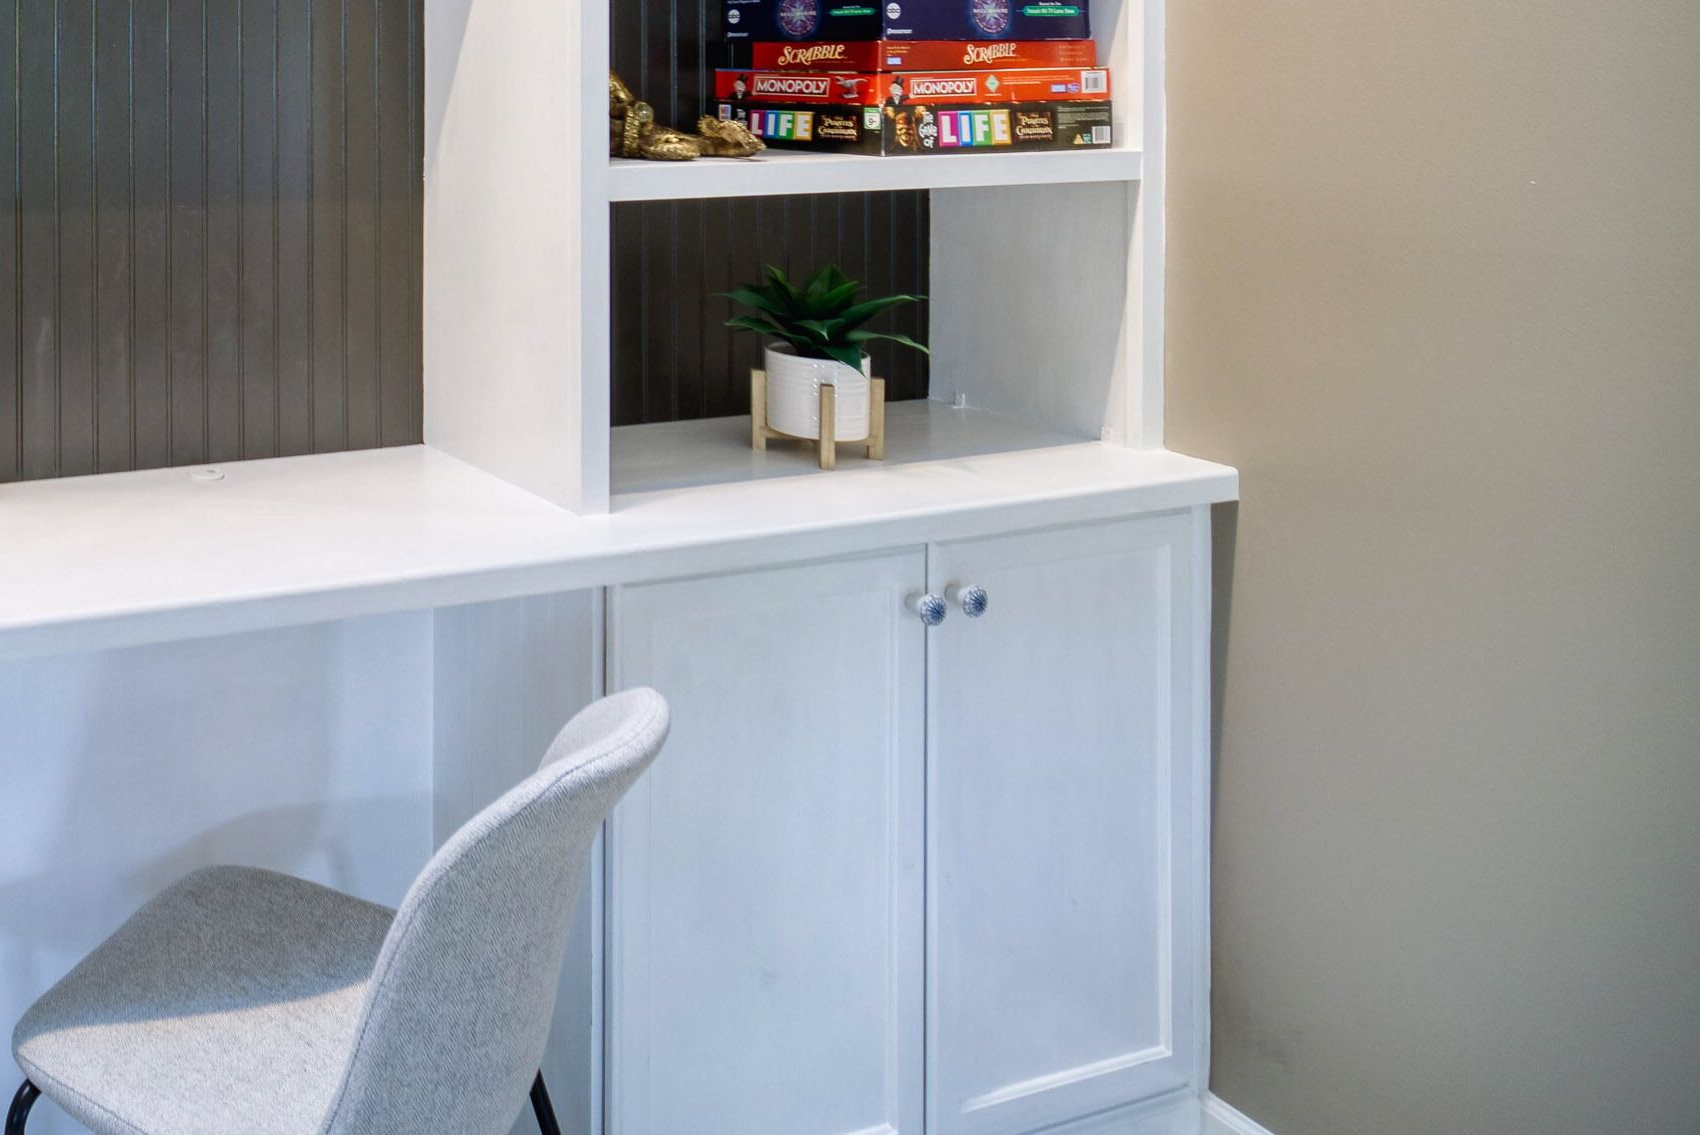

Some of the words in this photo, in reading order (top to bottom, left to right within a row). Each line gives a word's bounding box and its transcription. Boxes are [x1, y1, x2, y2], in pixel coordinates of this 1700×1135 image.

[777, 44, 845, 66] SCRABBLE
[963, 42, 1017, 64] SCRABBLE
[756, 79, 828, 94] MONOPOLY
[913, 80, 975, 95] MONOPOLY
[751, 112, 811, 138] LIFE
[941, 113, 1010, 143] LIFE
